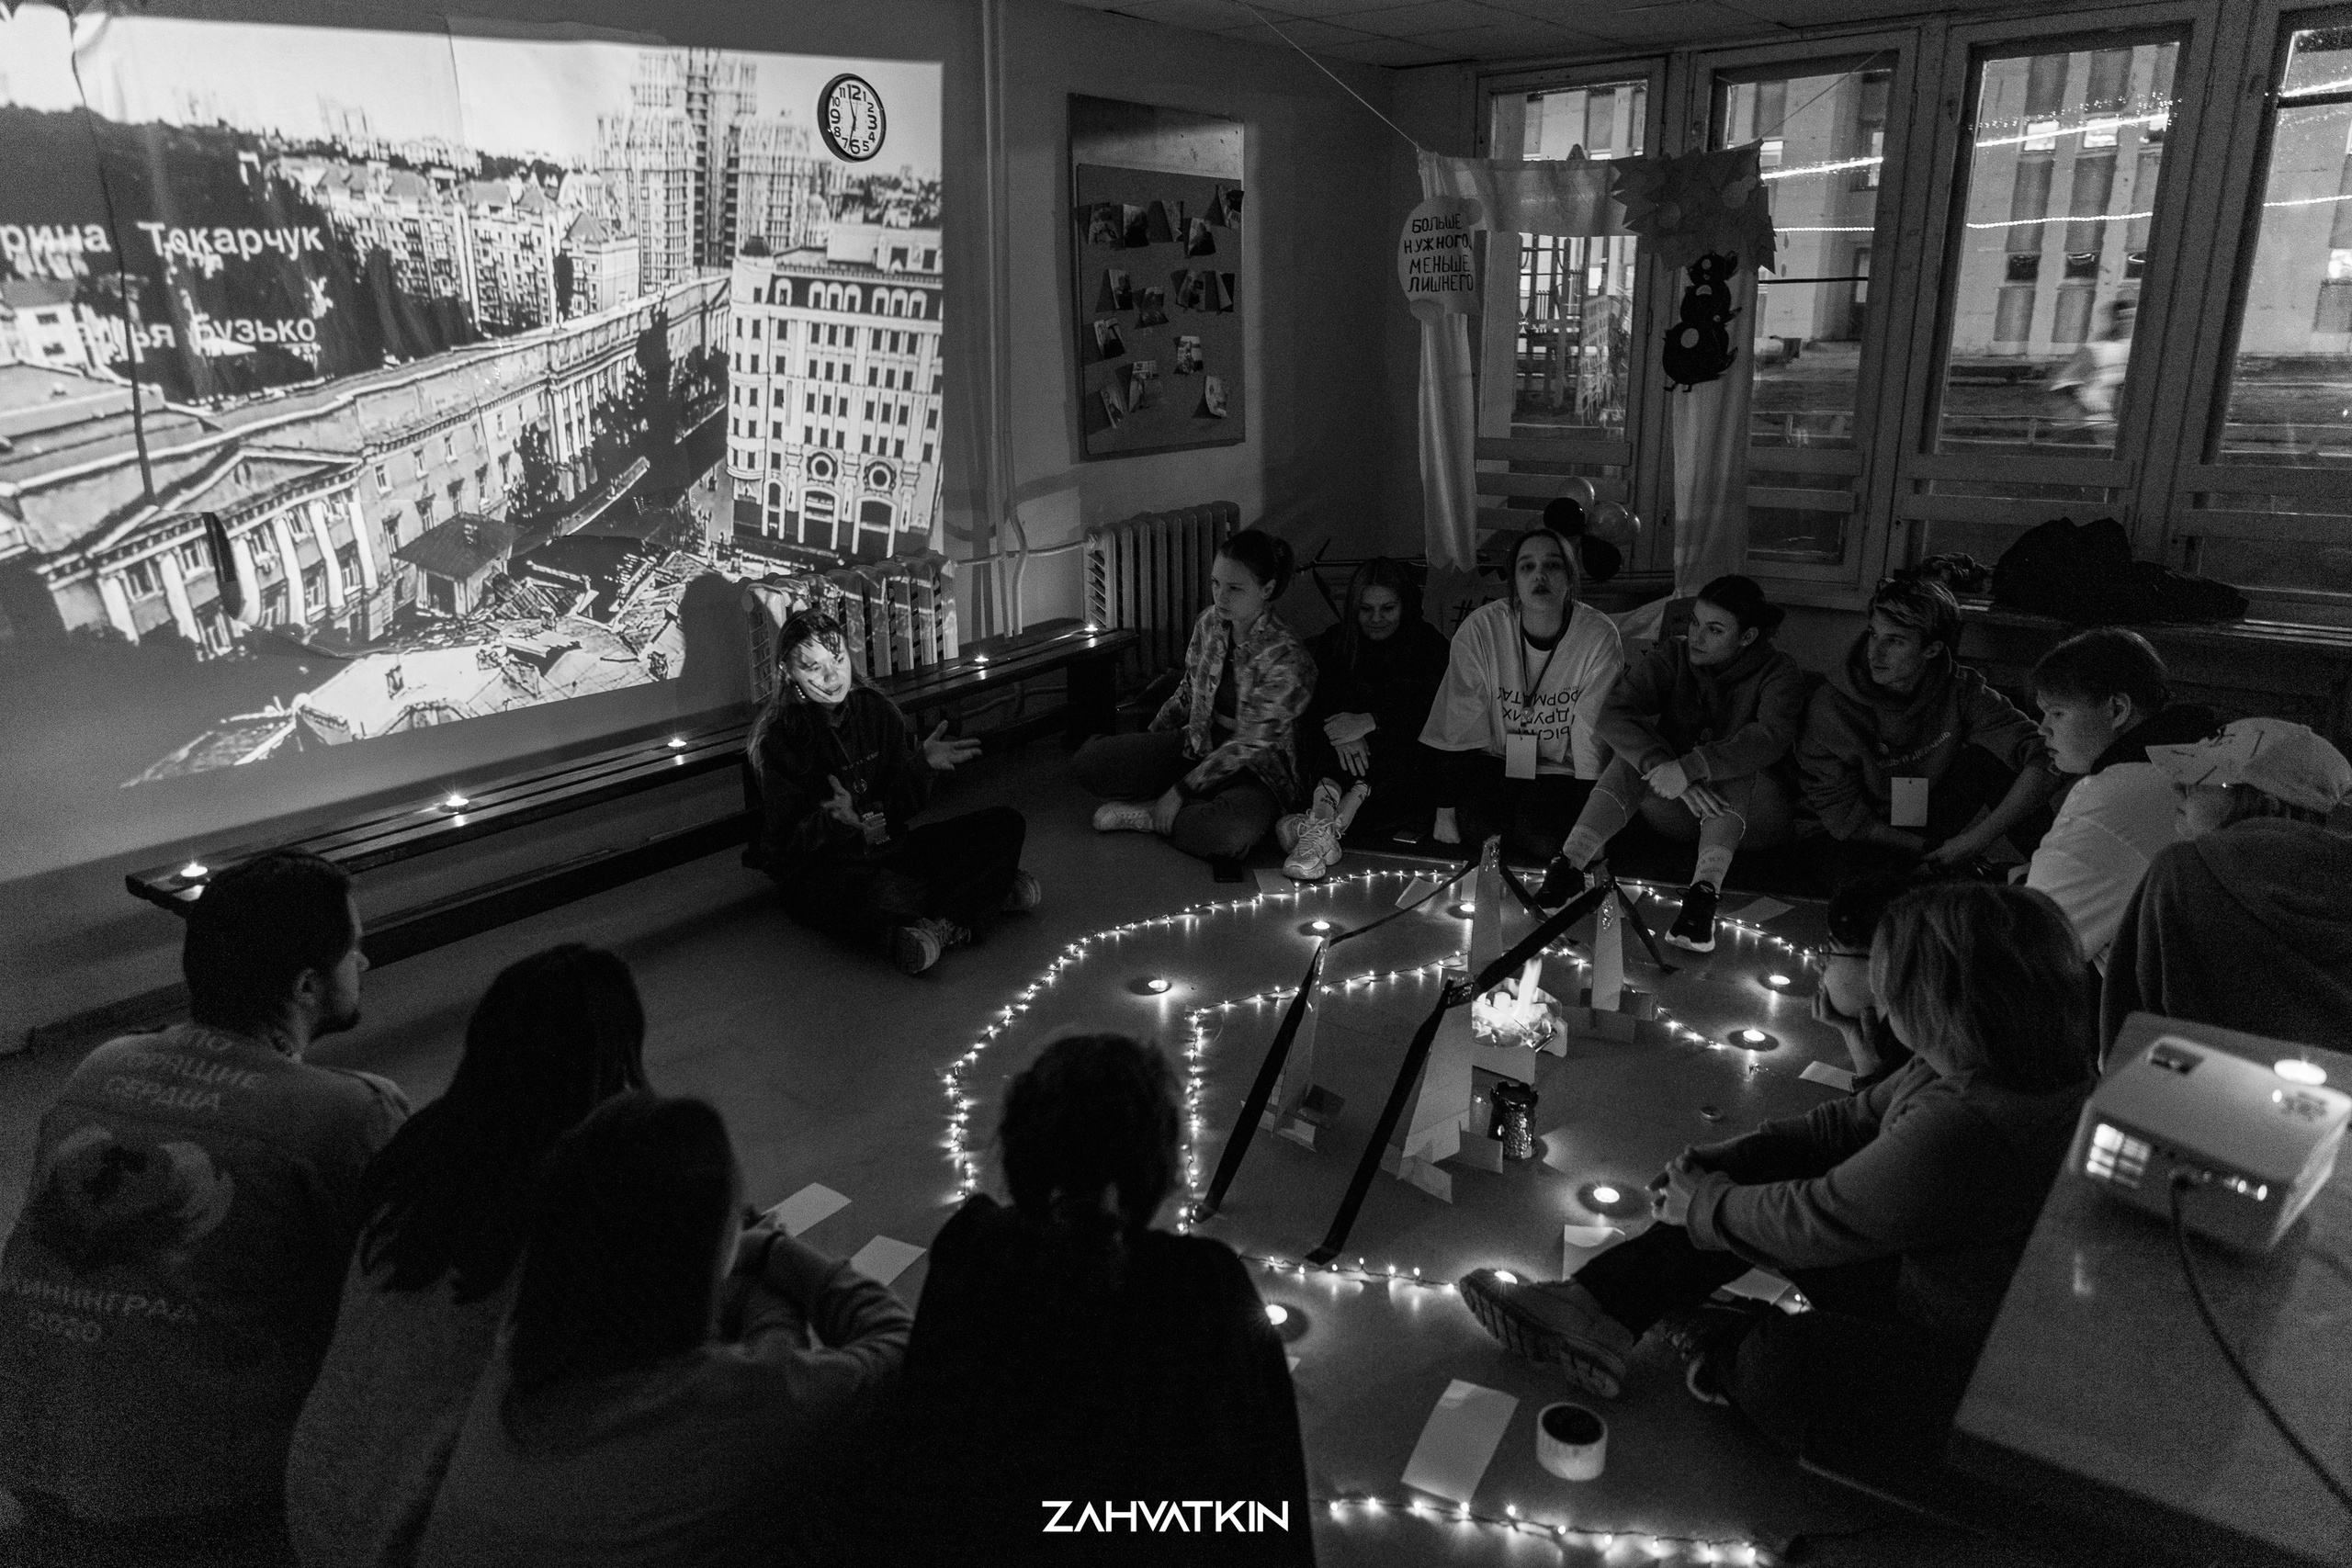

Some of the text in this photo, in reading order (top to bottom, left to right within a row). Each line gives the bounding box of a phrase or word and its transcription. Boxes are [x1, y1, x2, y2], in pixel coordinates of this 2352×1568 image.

[839, 87, 846, 98] 11
[847, 84, 862, 101] 12
[831, 96, 841, 107] 10
[867, 102, 875, 113] 2
[830, 108, 841, 124] 9
[867, 114, 877, 130] 3
[833, 126, 842, 138] 8
[868, 131, 876, 143] 4
[841, 137, 849, 149] 7
[850, 139, 861, 154] 6
[862, 141, 870, 152] 5
[1411, 213, 1462, 233] БОЛЬШЕ
[137, 220, 325, 263] Токарчук
[1404, 233, 1472, 254] НУЖНОГО,
[1409, 254, 1470, 275] МЕНЬШЕ
[1408, 274, 1474, 293] ЛИШНЕГО
[191, 312, 316, 345] Бузько
